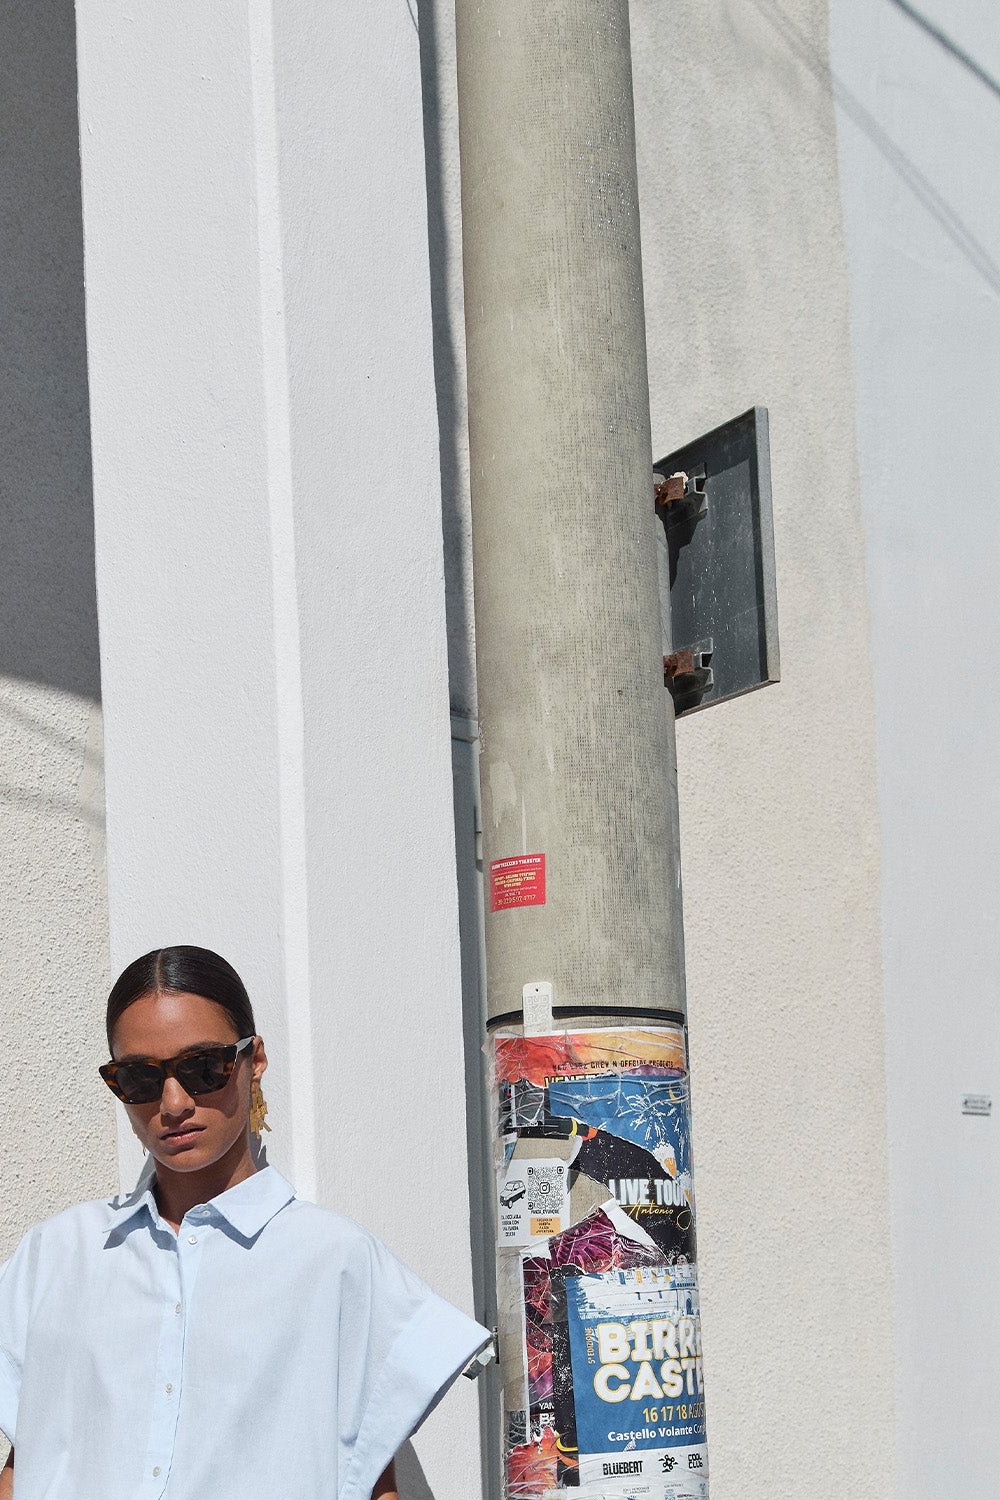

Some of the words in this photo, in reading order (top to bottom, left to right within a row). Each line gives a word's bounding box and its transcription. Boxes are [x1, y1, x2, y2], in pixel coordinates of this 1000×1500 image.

[642, 1406, 659, 1423] 16
[660, 1405, 674, 1421] 17
[676, 1403, 687, 1420] 18
[607, 1427, 657, 1442] Castello
[658, 1425, 693, 1438] Volante
[602, 1460, 644, 1476] BLUEBEAT
